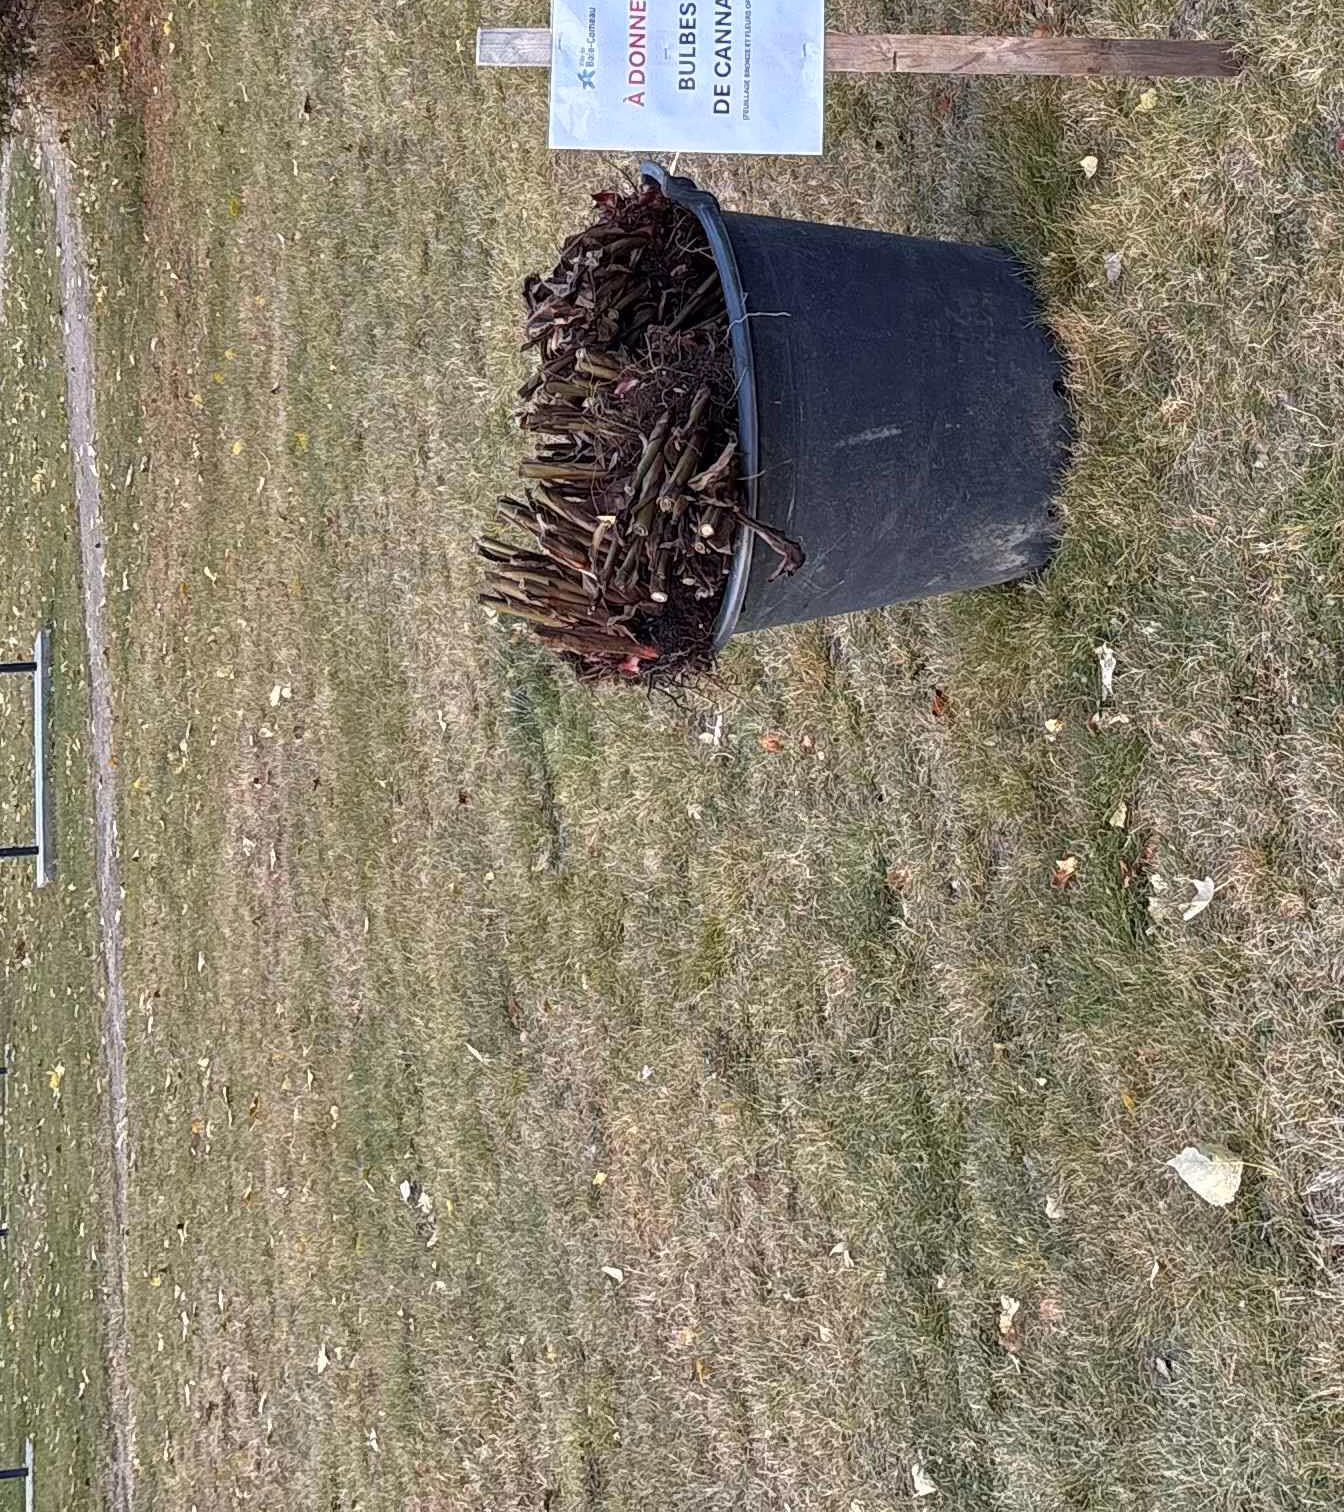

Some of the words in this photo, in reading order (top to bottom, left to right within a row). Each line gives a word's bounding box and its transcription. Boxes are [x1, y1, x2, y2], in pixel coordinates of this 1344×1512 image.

[585, 7, 596, 68] Baie-Comeau
[678, 2, 696, 90] BULBES
[622, 91, 645, 108] À
[713, 84, 731, 114] DE
